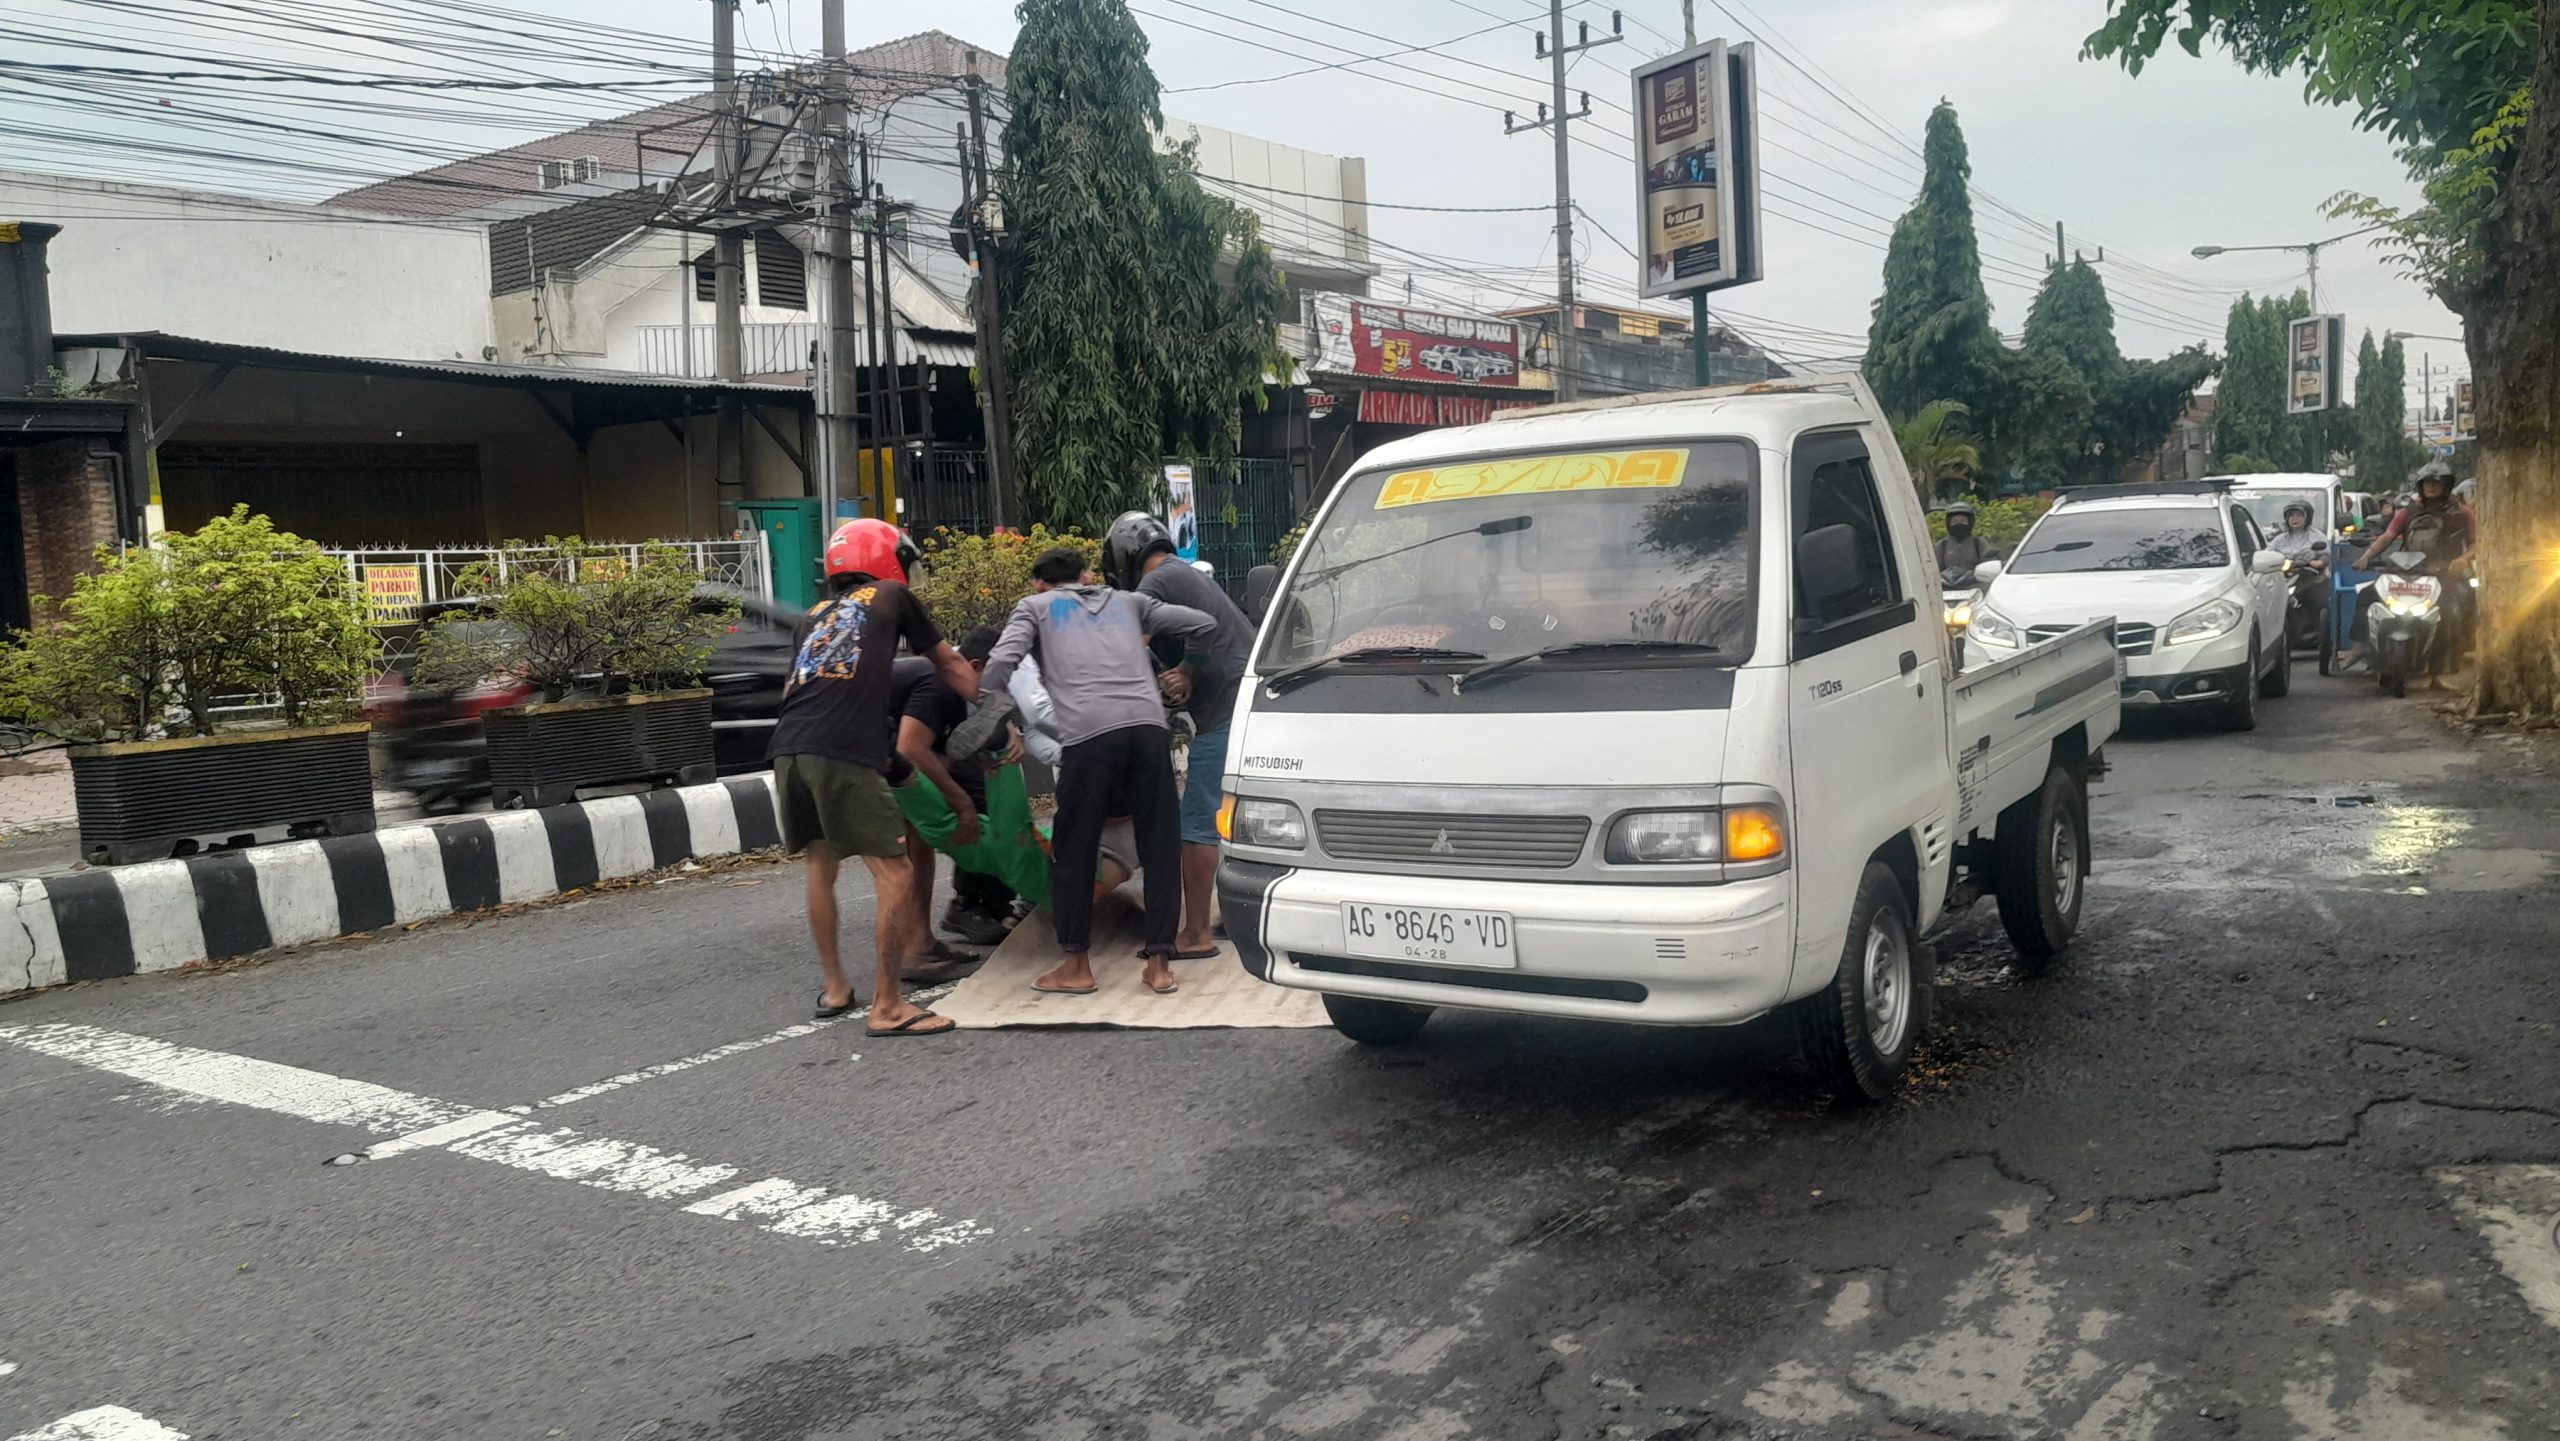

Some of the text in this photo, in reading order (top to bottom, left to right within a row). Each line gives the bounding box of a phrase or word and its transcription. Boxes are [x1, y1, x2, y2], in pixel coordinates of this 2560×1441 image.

[1698, 62, 1708, 126] KRETEK
[1658, 104, 1694, 126] GARAM
[1446, 317, 1475, 339] SIAP
[1475, 321, 1512, 344] PAKAI
[1357, 389, 1437, 426] ARMADA
[369, 568, 415, 579] DILARANG
[371, 580, 417, 593] PARKIR
[386, 593, 418, 606] DEPAN
[373, 606, 420, 621] PAGAR
[1243, 755, 1304, 771] MITSUBISHI
[1350, 904, 1508, 949] AG 8646 VD
